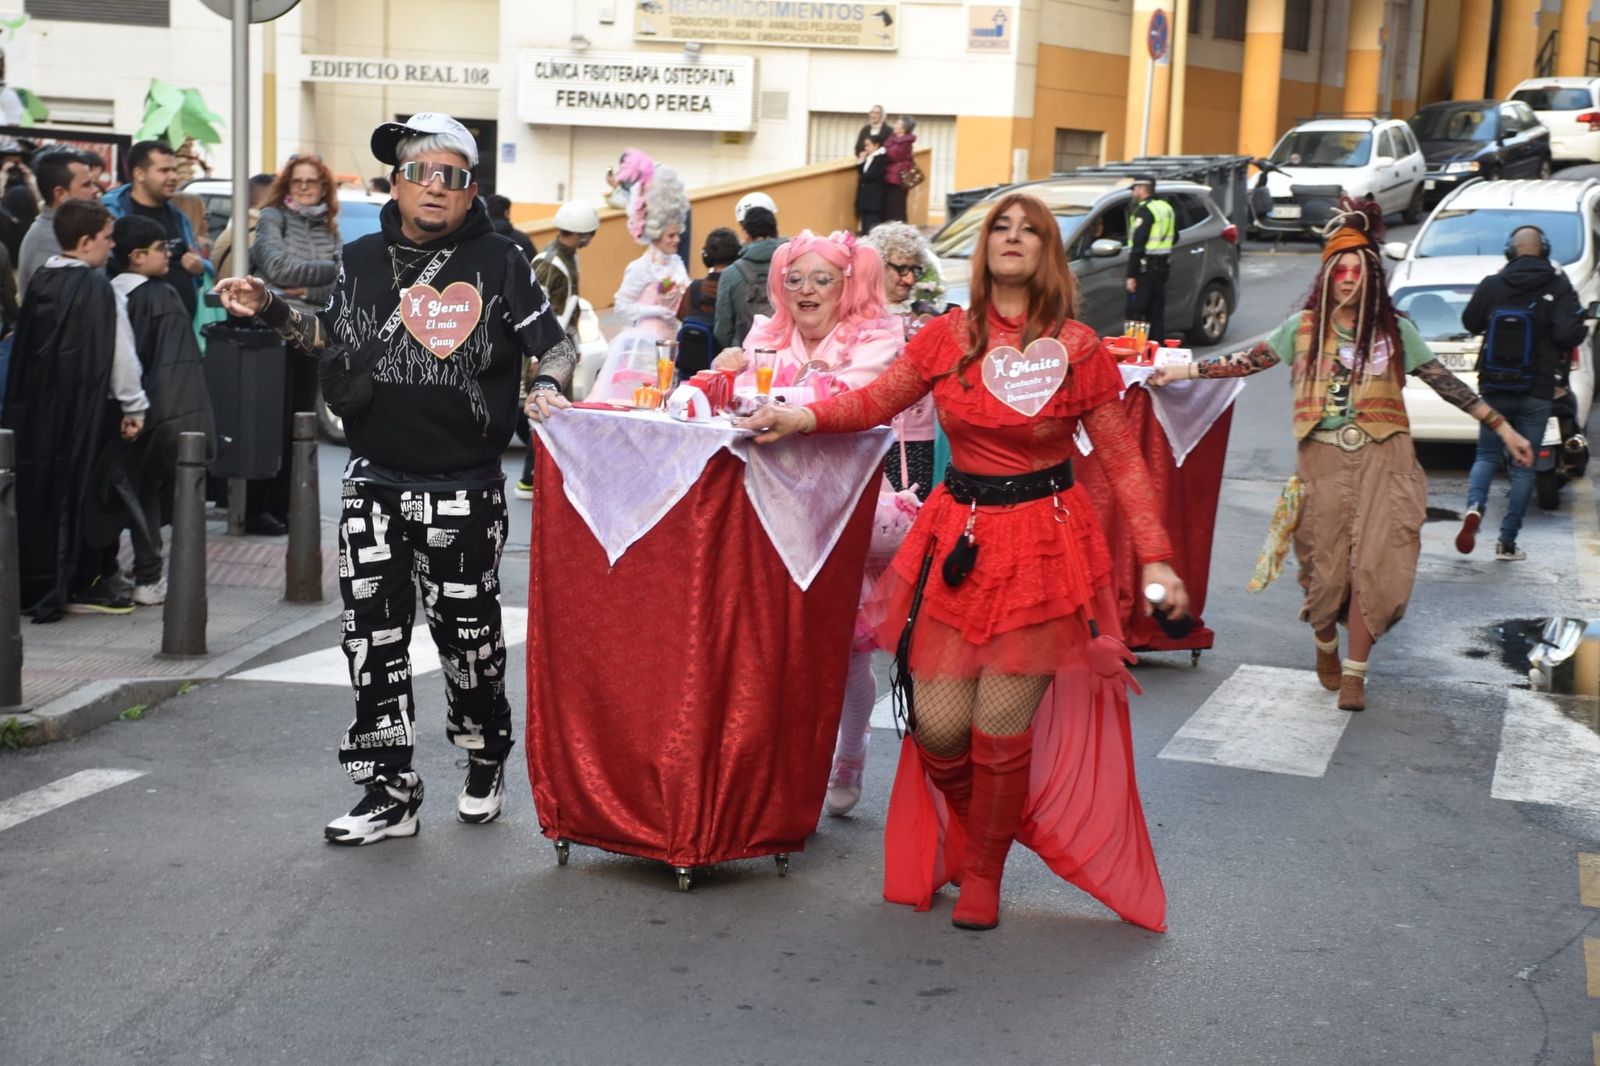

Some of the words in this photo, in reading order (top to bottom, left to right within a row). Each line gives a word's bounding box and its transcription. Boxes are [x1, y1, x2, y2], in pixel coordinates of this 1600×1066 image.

[669, 0, 865, 20] RECONOCIMIENTOS
[310, 60, 399, 80] EDIFICIO
[404, 64, 457, 83] REAL
[463, 68, 490, 84] 108
[583, 64, 660, 83] FISIOTERAPIA
[664, 67, 735, 85] OSTEOPATIA
[556, 89, 650, 110] FERNANDO
[655, 94, 713, 112] PEREA
[428, 300, 470, 317] Yerai
[426, 319, 436, 329] El
[438, 318, 457, 329] más
[430, 336, 455, 348] Guay
[1009, 358, 1060, 377] Maite
